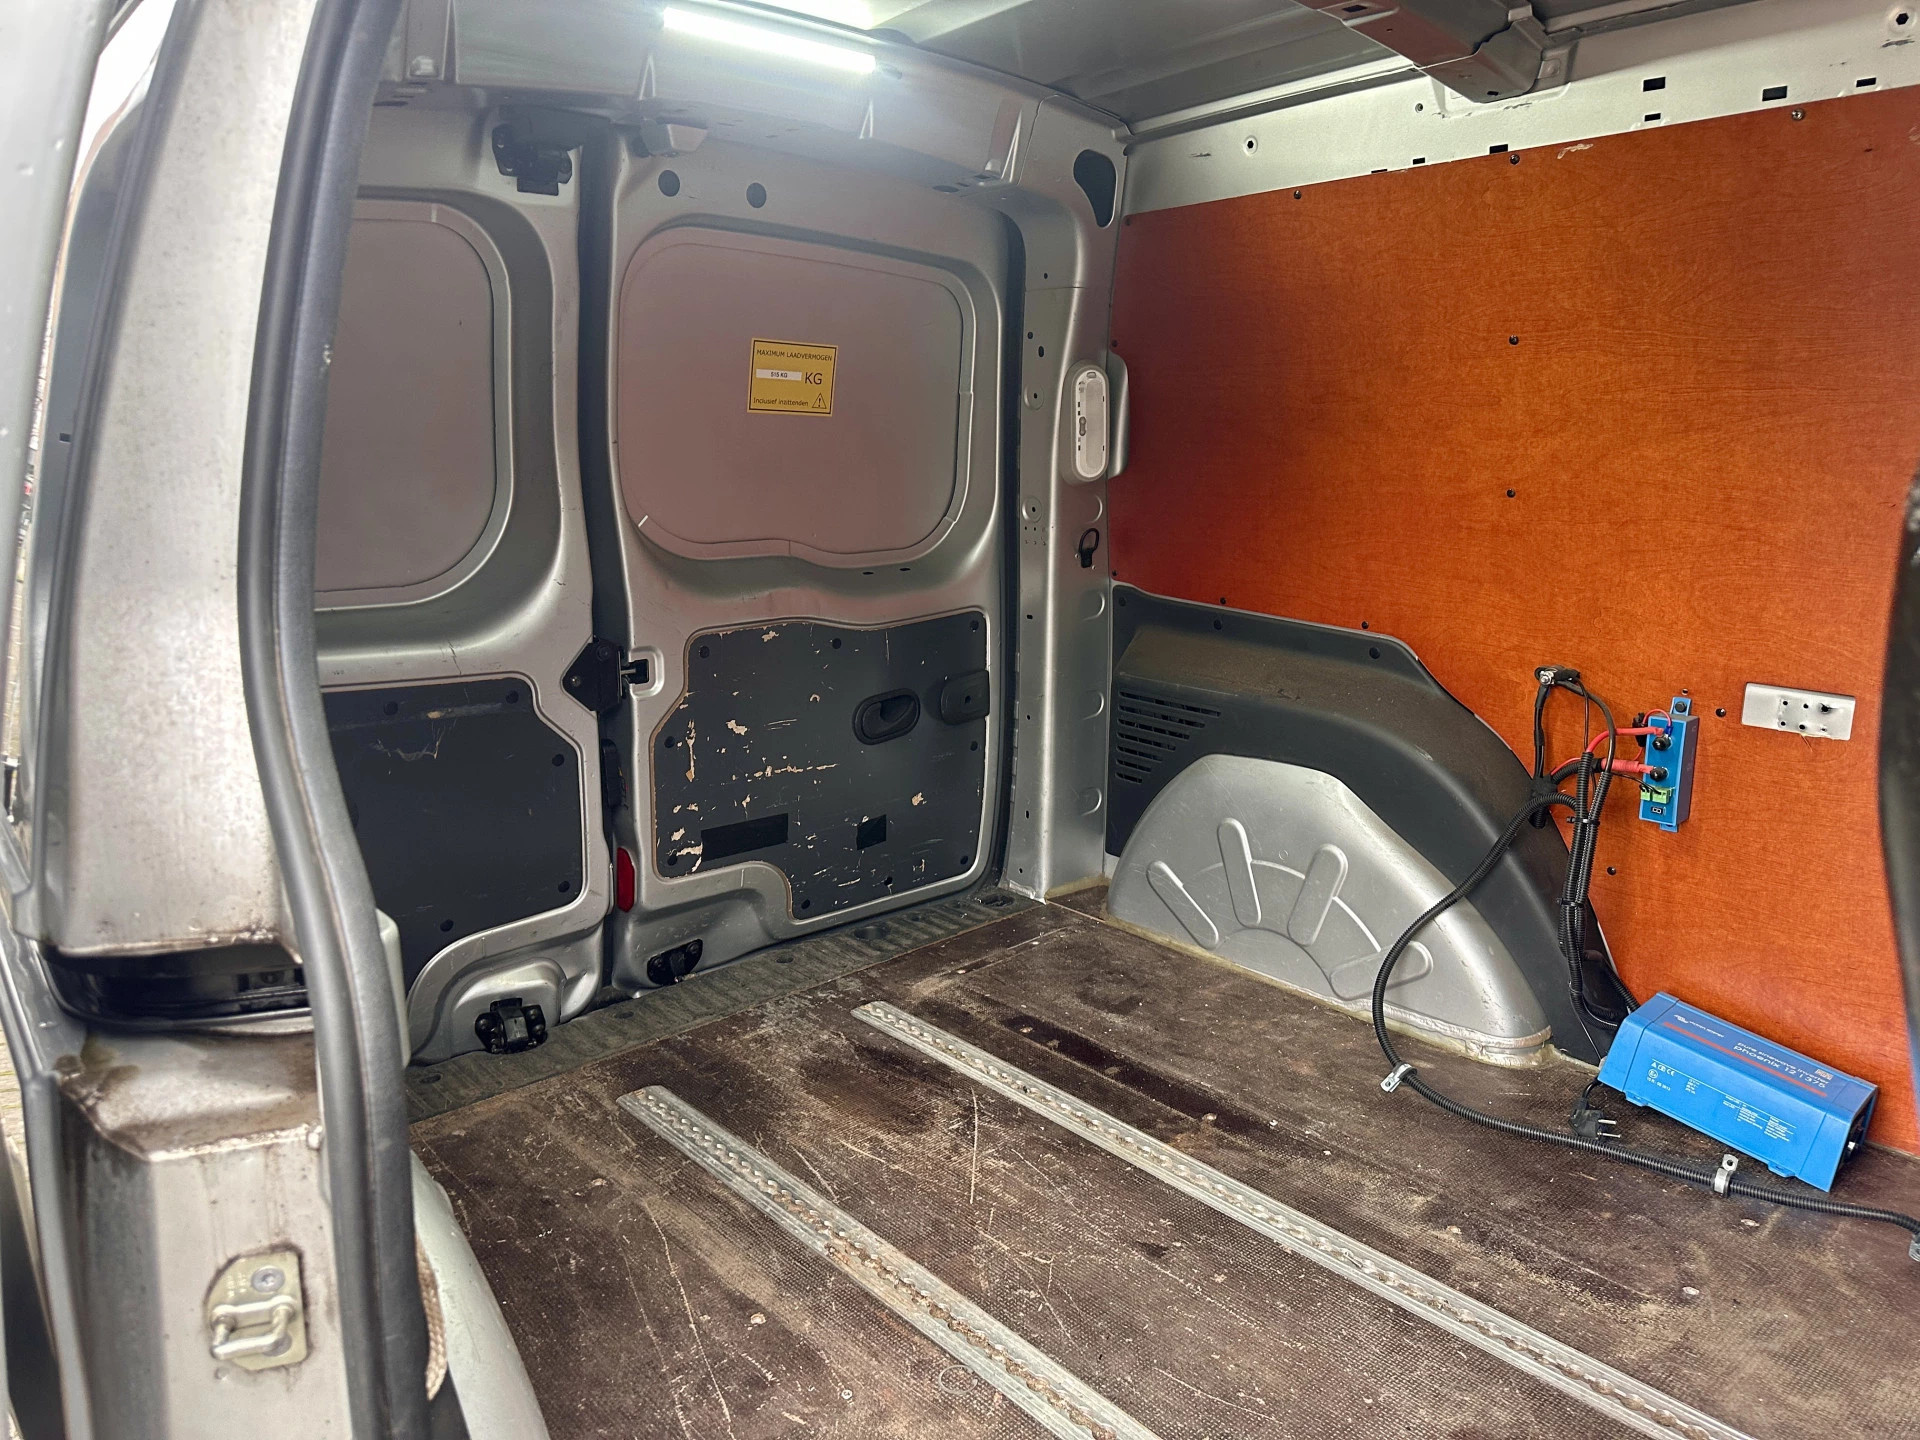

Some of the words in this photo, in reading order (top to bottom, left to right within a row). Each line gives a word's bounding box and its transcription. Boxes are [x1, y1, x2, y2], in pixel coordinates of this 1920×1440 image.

[756, 349, 785, 357] MAXIMUM
[786, 352, 833, 361] LAADVERMOGEN
[804, 372, 823, 385] KG
[753, 397, 778, 405] Inclusief
[1737, 1042, 1757, 1052] pure
[1733, 1045, 1781, 1069] phoenix
